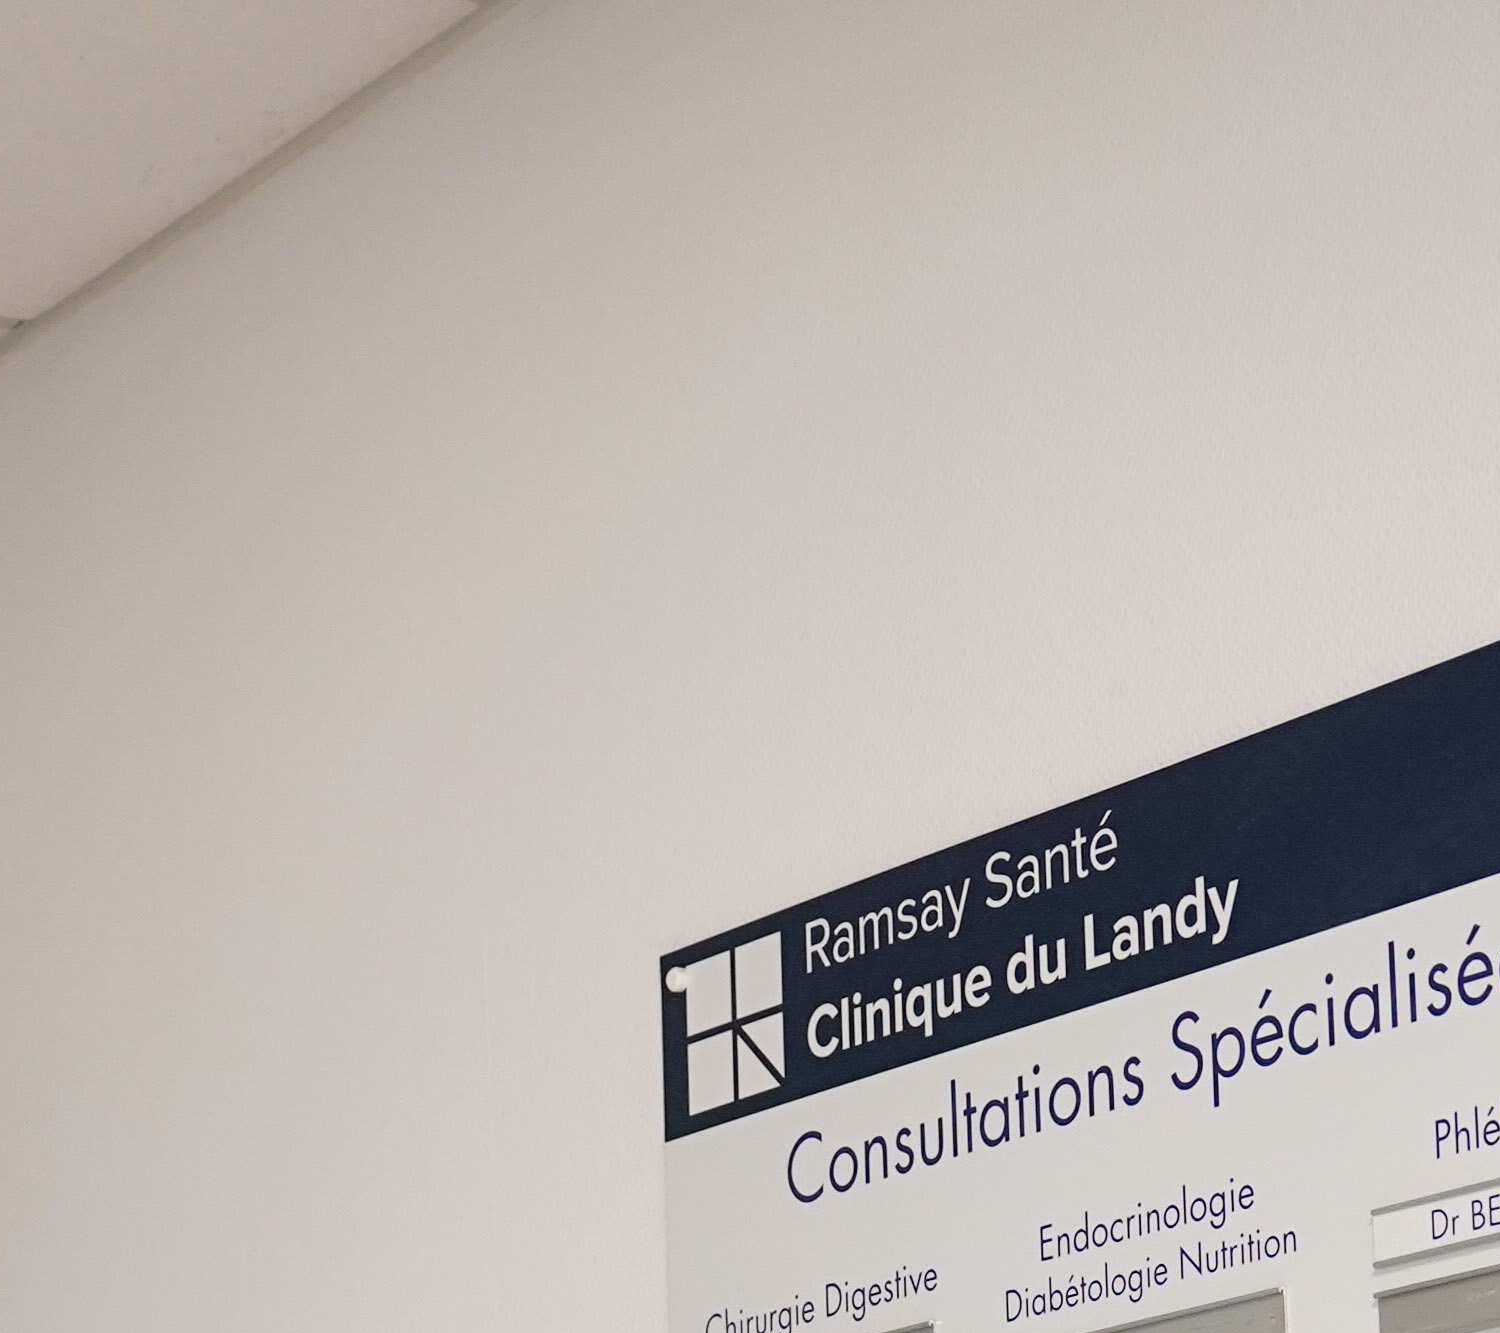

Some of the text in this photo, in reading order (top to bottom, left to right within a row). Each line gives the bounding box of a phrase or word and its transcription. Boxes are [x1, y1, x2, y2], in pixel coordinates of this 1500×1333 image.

[804, 809, 1118, 973] Ramsay Santé
[806, 875, 1240, 1059] Clinique du Landy
[786, 1056, 1145, 1203] Consultations
[1039, 1177, 1255, 1262] Endocrinologie
[1430, 1208, 1460, 1241] Dr
[825, 1265, 938, 1322] Digestive
[1005, 1228, 1297, 1322] Diabétologie Nutrition
